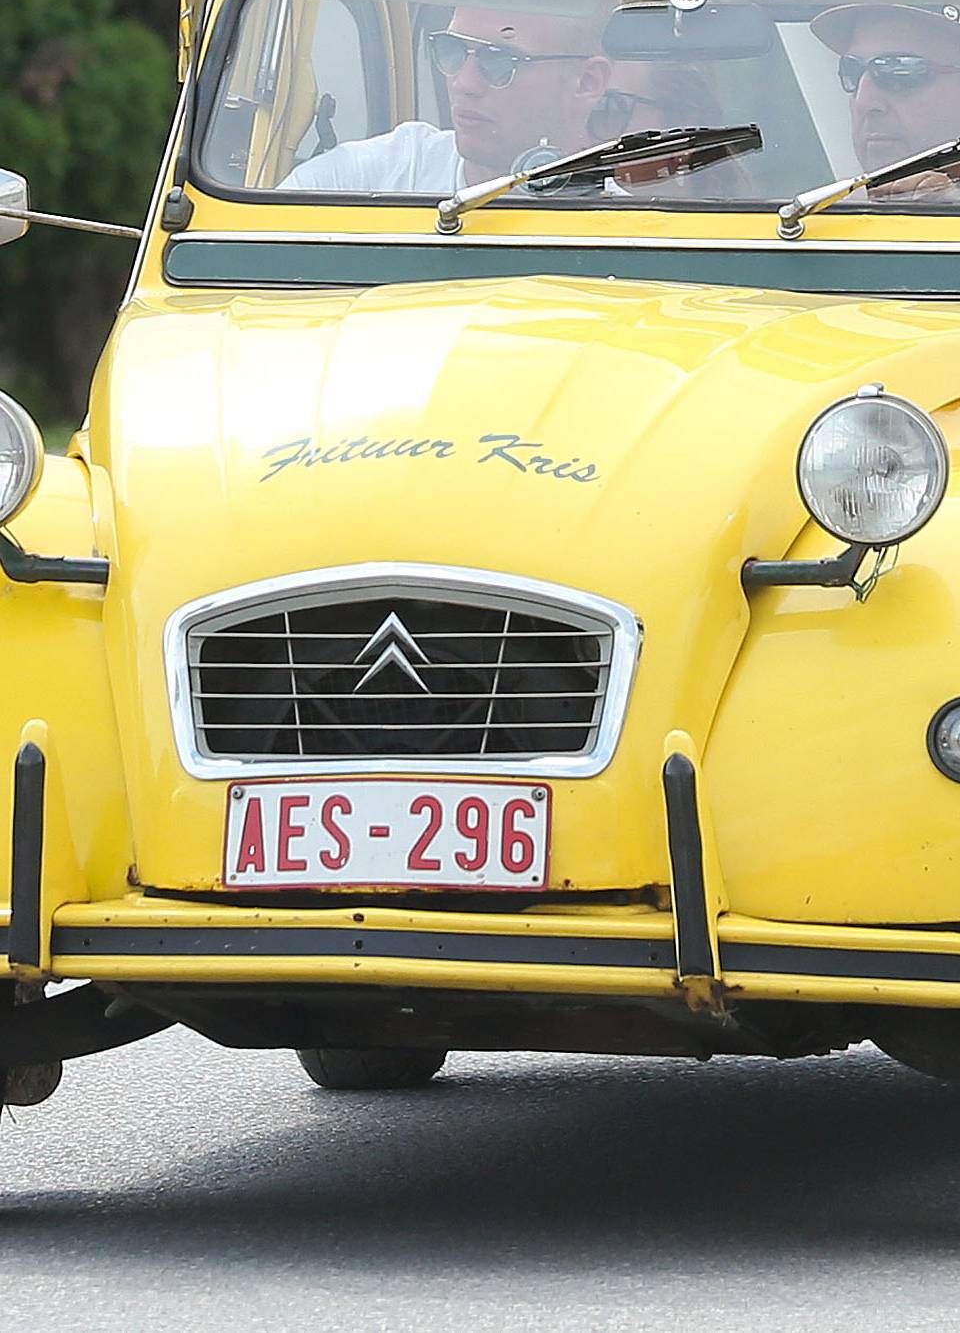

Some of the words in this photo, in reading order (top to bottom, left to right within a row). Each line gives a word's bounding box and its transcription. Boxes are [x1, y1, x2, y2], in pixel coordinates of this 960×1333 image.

[258, 436, 457, 483] Frituur
[477, 433, 602, 483] Kris
[235, 794, 537, 874] AES-296
